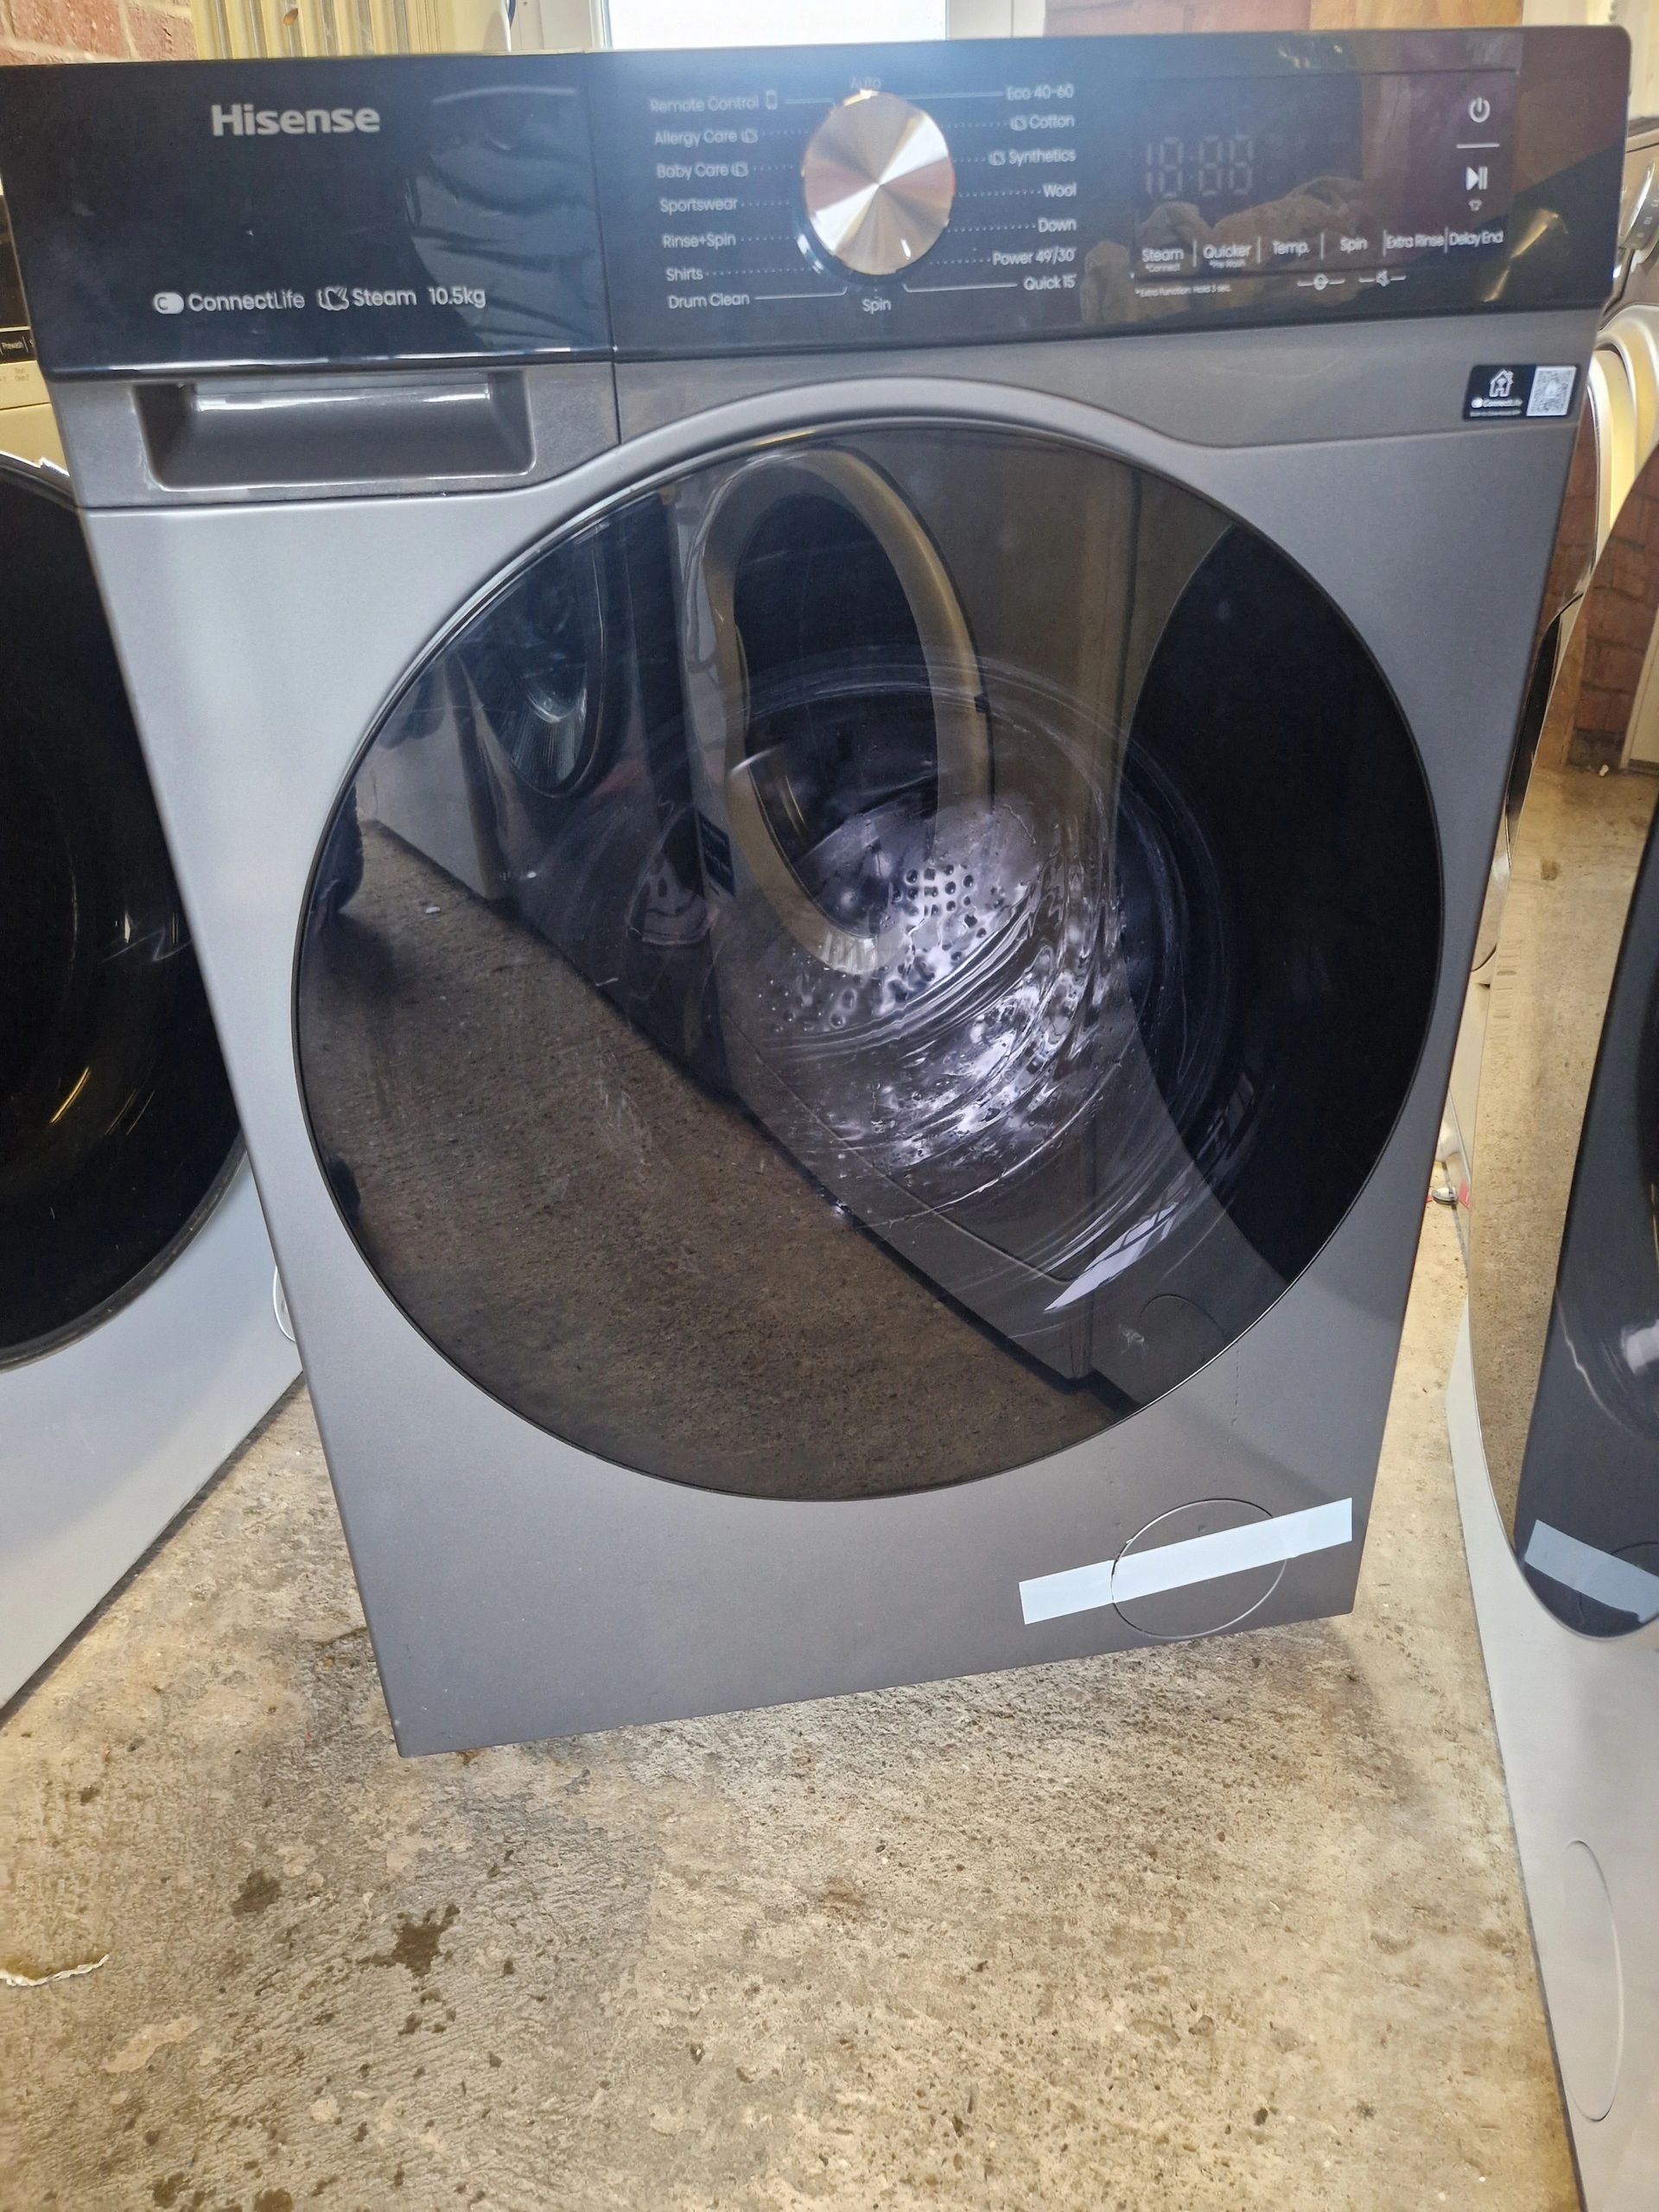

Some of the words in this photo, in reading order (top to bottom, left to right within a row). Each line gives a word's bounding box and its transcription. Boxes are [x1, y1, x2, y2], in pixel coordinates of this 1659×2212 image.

[1007, 86, 1031, 100] Eco
[1034, 84, 1074, 99] 40-60
[650, 98, 704, 113] Remote
[709, 95, 760, 111] Control
[211, 103, 381, 137] Hisense
[1029, 114, 1074, 130] Cotton
[655, 130, 701, 148] Allergy
[703, 130, 737, 143] Care
[1008, 149, 1077, 167] Synthetics
[657, 162, 692, 181] Baby
[695, 162, 729, 177] Care
[1042, 182, 1077, 198] Wool
[660, 197, 738, 215] Sportswear
[1038, 217, 1077, 232] Down
[662, 231, 736, 250] Rinse+Spin
[1340, 237, 1369, 253] Spin
[1386, 234, 1414, 249] Extra
[1414, 233, 1445, 247] Rinse
[1449, 232, 1481, 247] Delay
[1482, 231, 1503, 244] End
[1141, 248, 1185, 263] Steam
[1203, 245, 1252, 259] Quicker
[1272, 240, 1310, 257] Temp.
[992, 251, 1033, 265] Power
[665, 266, 703, 282] Shirts
[1023, 276, 1062, 290] Quick
[188, 289, 305, 312] ConnectLife
[352, 286, 417, 307] Steam
[428, 286, 486, 308] 10.5kg
[668, 295, 707, 308] Drum
[709, 292, 750, 307] Clean
[862, 298, 891, 315] Spin
